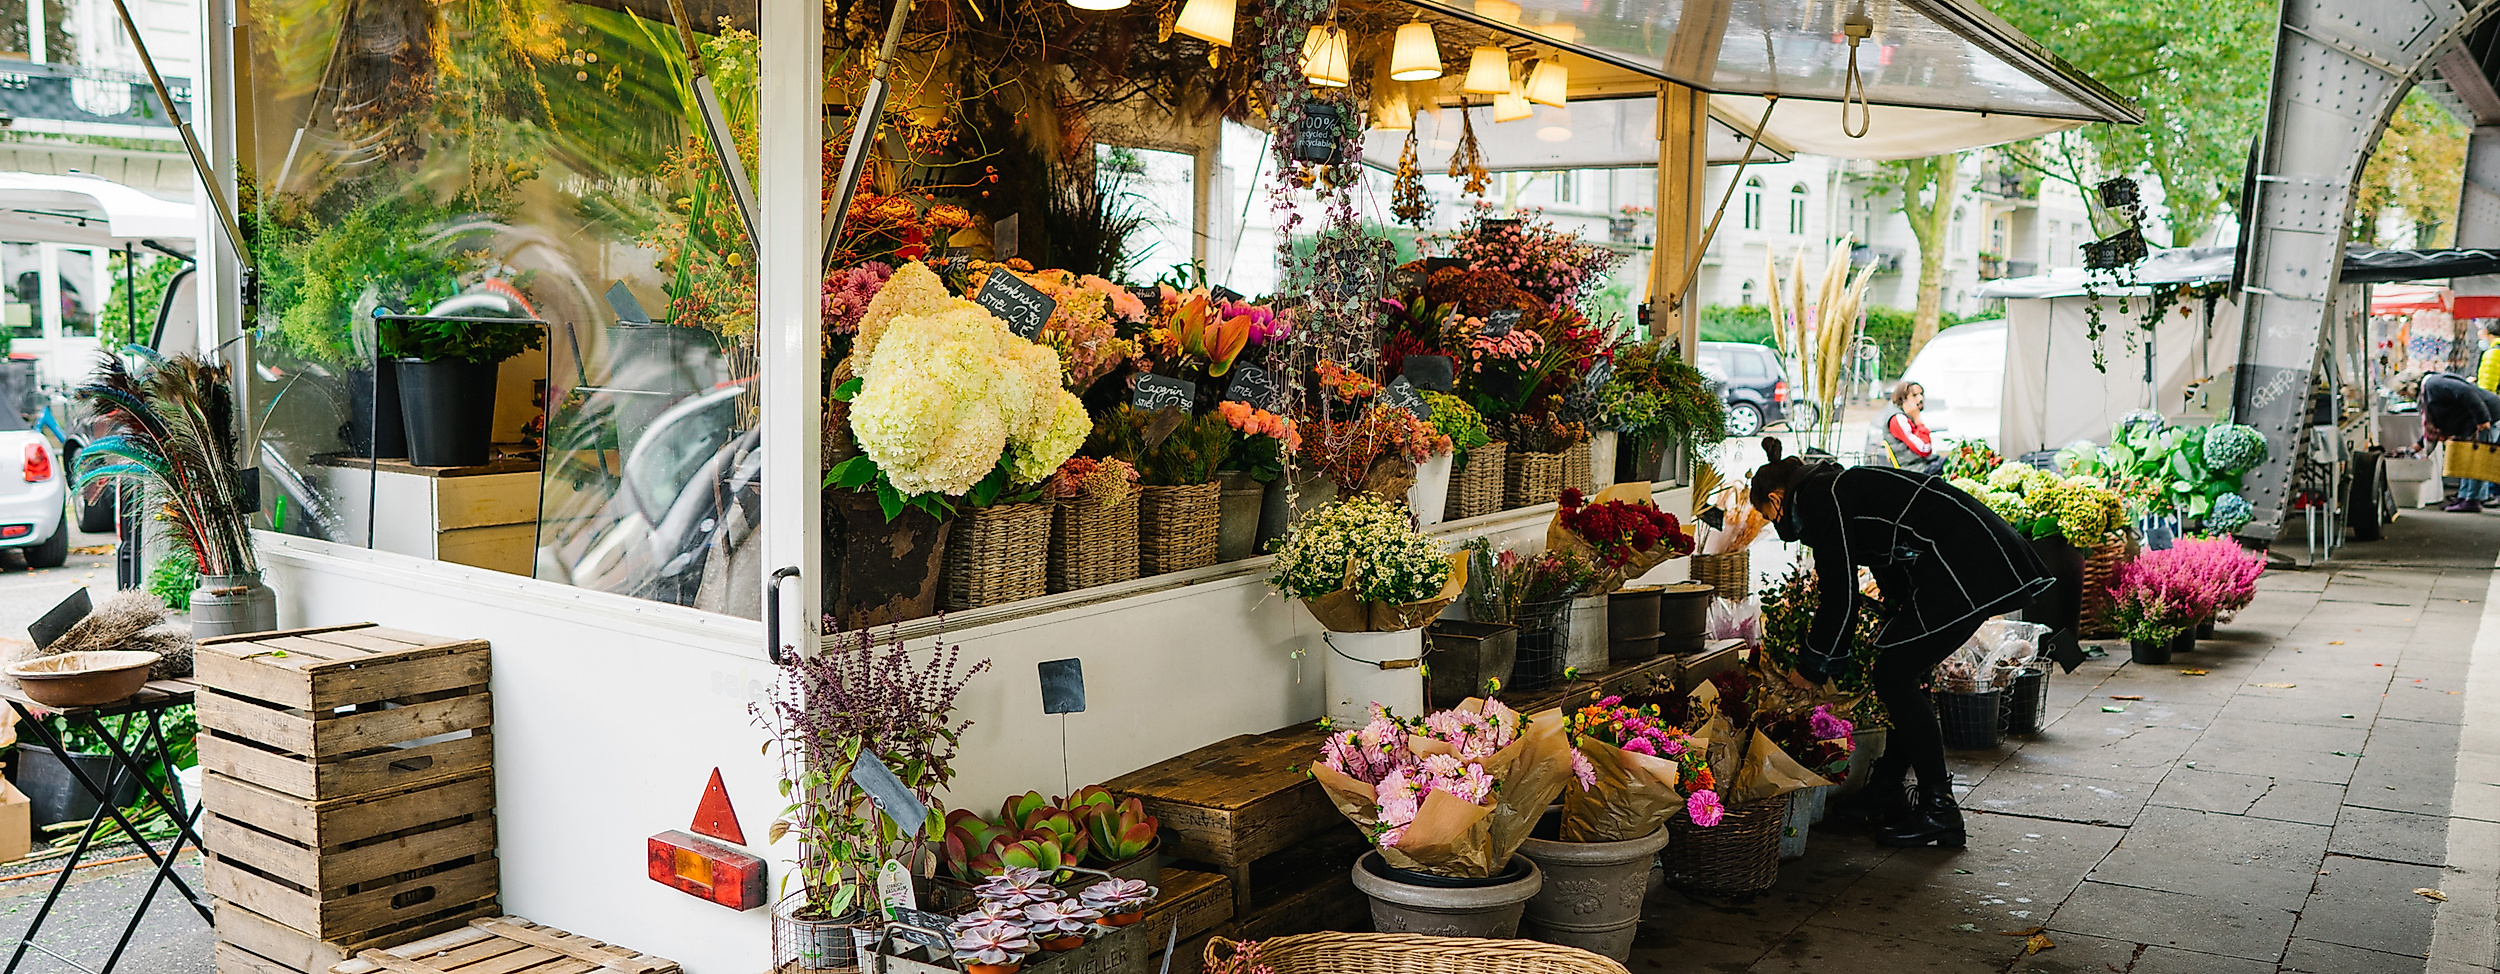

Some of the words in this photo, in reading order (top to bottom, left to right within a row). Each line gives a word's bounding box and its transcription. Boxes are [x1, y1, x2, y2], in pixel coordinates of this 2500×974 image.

[1301, 116, 1335, 131] 100%
[1300, 130, 1328, 139] recycled
[980, 292, 1008, 313] STIEL
[1230, 384, 1253, 398] STIEL
